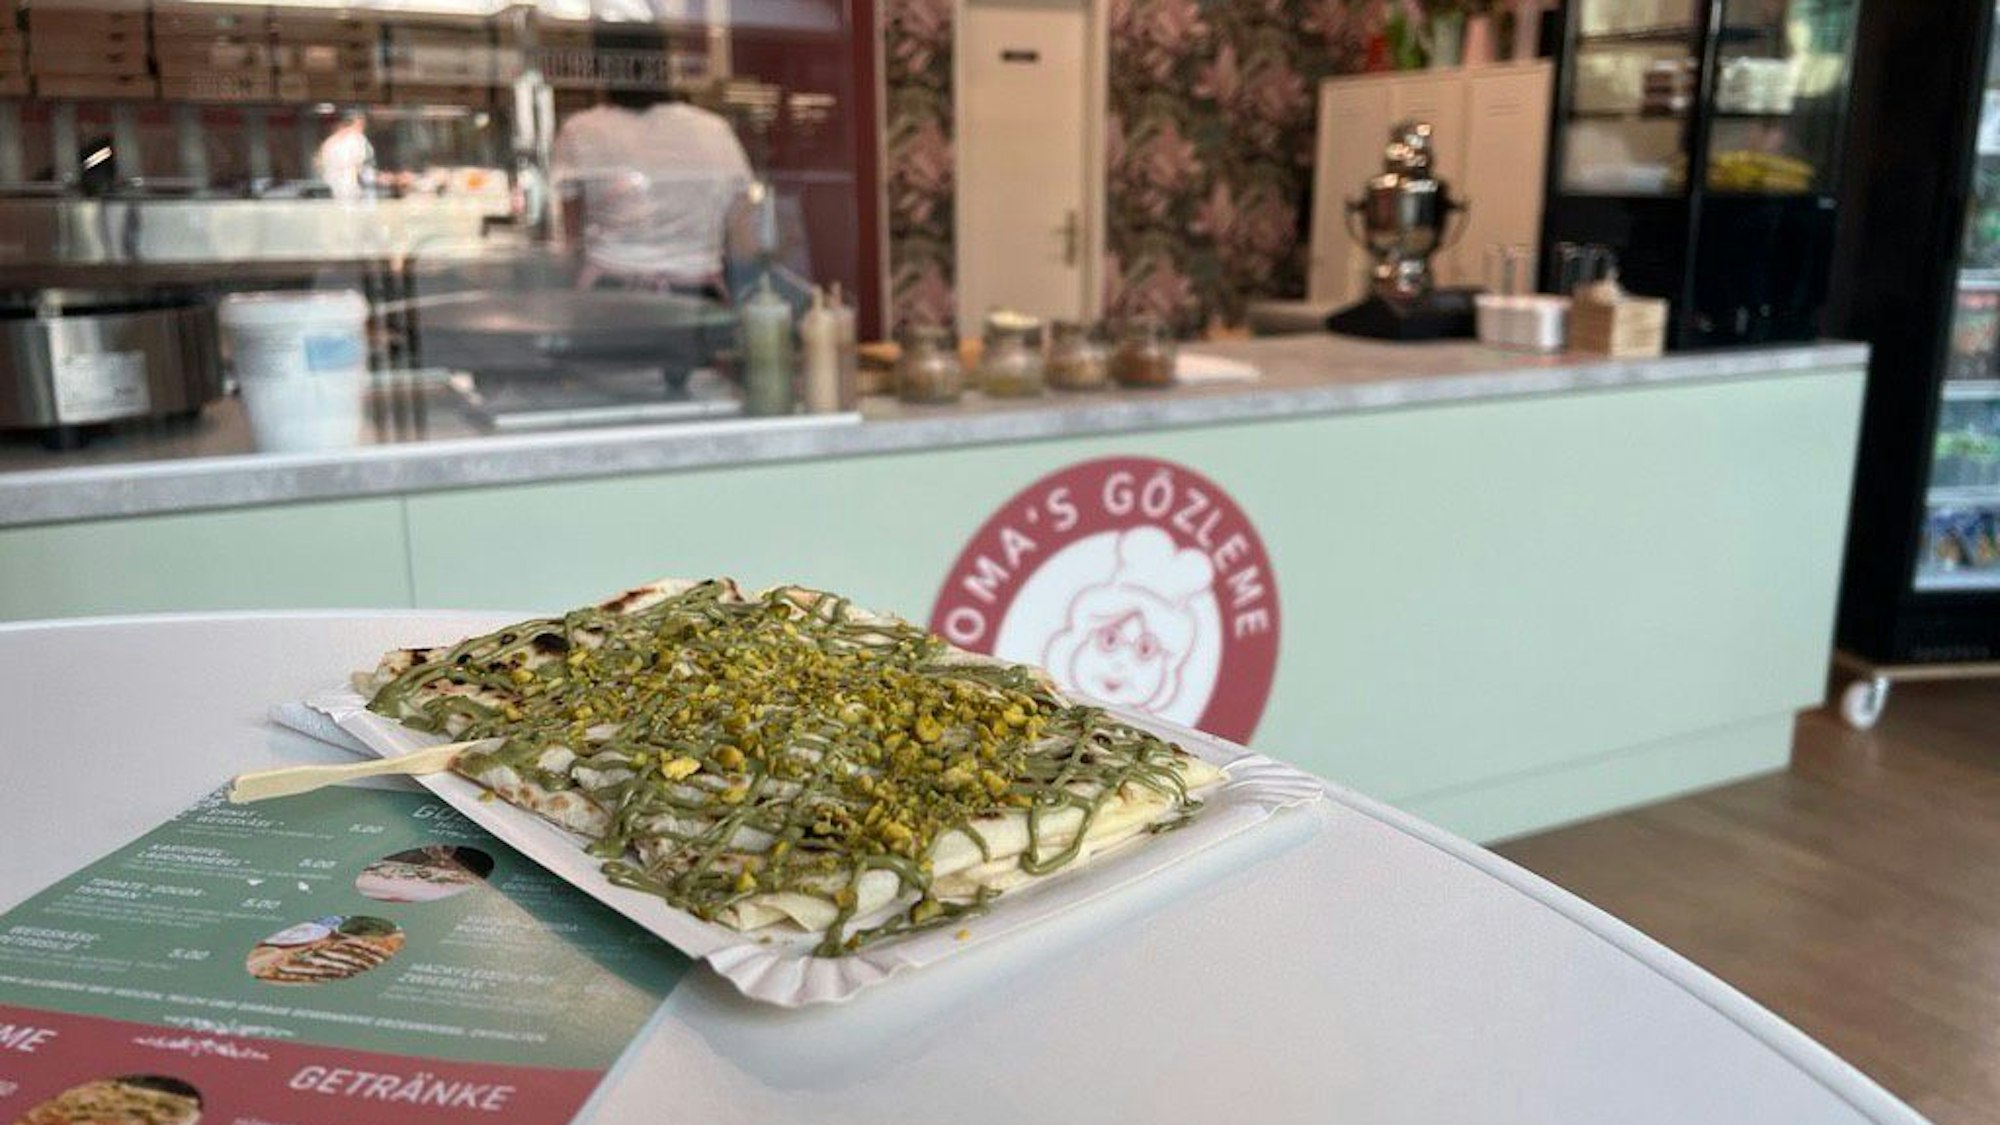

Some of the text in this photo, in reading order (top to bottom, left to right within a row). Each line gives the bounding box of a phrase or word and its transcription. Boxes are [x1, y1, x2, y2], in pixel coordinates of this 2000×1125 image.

[944, 467, 1271, 645] OMA'S GÖZLEME
[288, 1064, 517, 1111] GETRÄNKE
